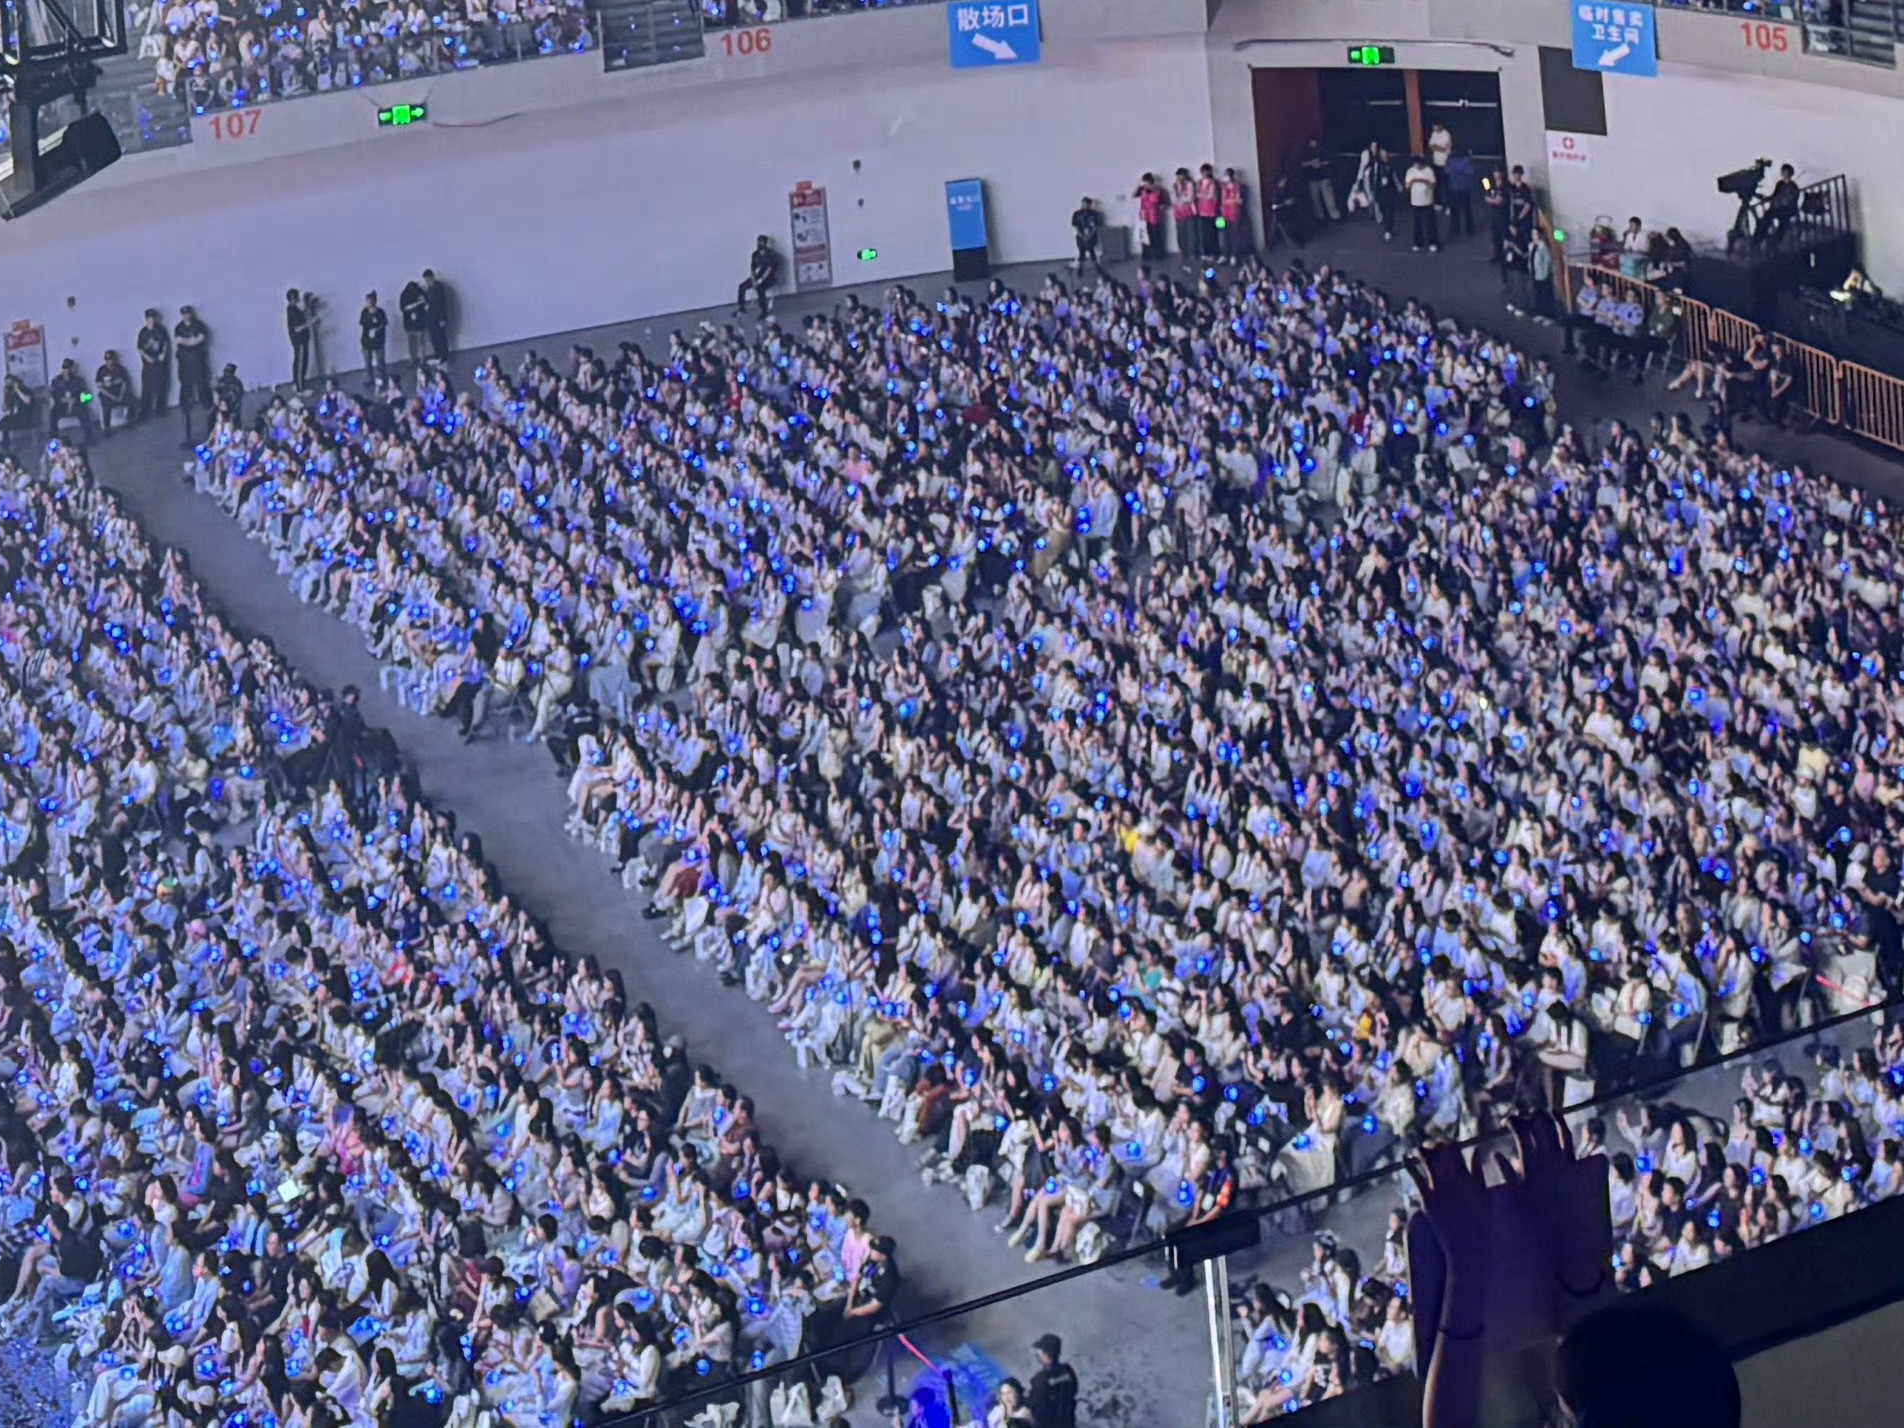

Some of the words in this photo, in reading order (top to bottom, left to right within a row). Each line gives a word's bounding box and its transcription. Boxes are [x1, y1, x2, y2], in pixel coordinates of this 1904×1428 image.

[957, 3, 1030, 32] 散场口
[722, 26, 773, 58] 106
[1741, 21, 1791, 55] 105
[210, 109, 265, 143] 107
